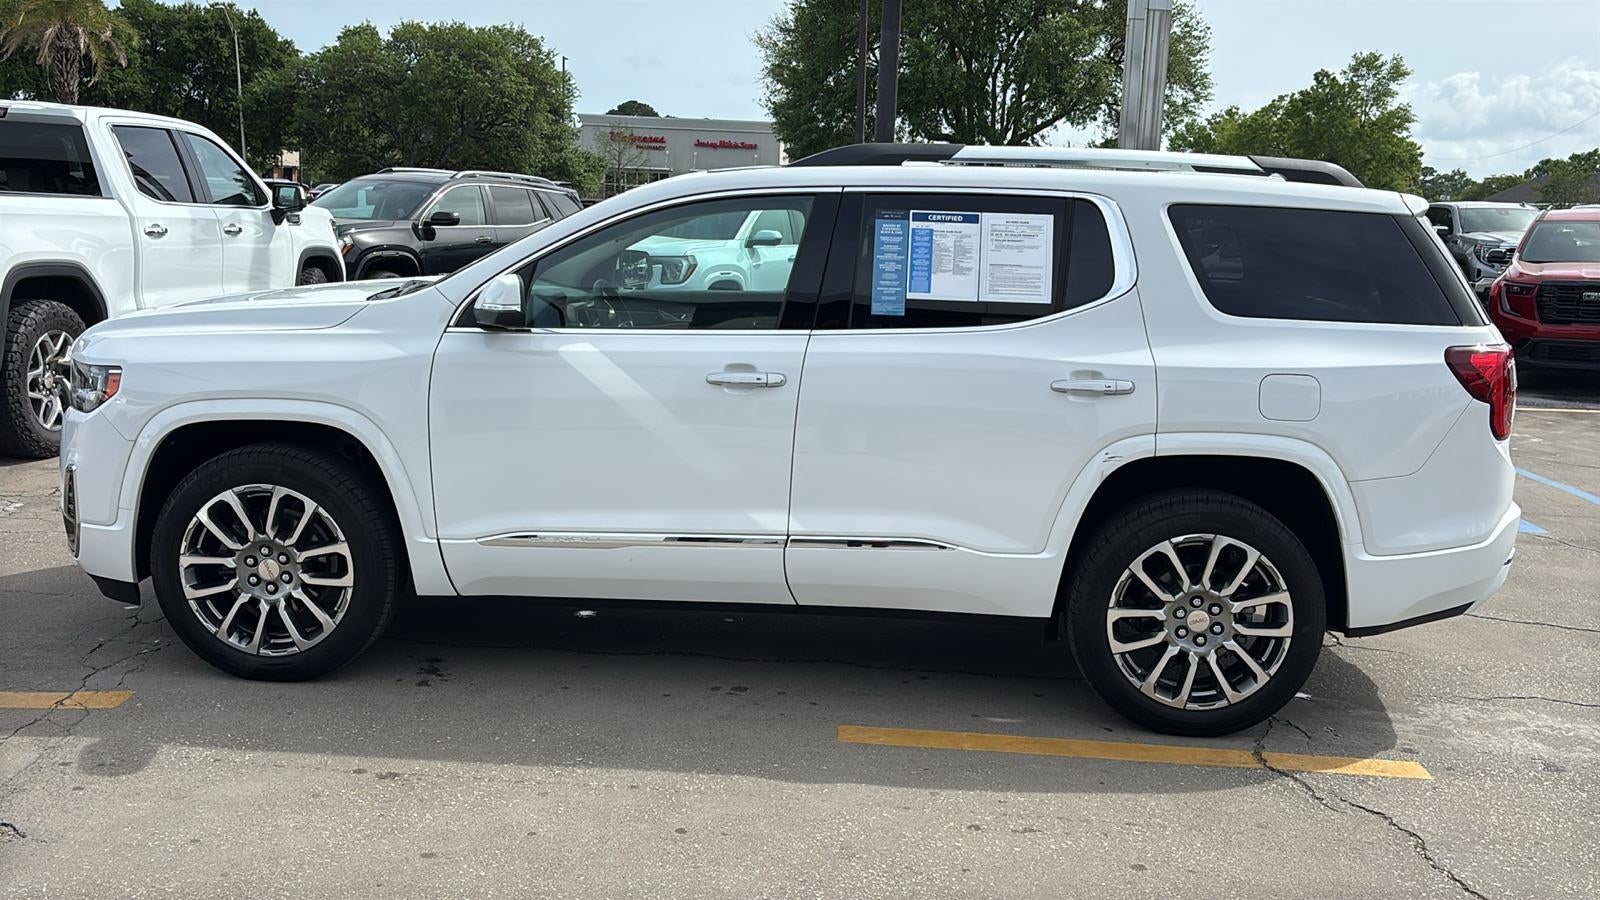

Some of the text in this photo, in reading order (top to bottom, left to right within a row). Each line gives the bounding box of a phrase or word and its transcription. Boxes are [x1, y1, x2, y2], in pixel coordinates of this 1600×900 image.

[694, 139, 718, 149] Jersey
[928, 214, 963, 222] CERTIFIED
[1189, 617, 1208, 625] GMC
